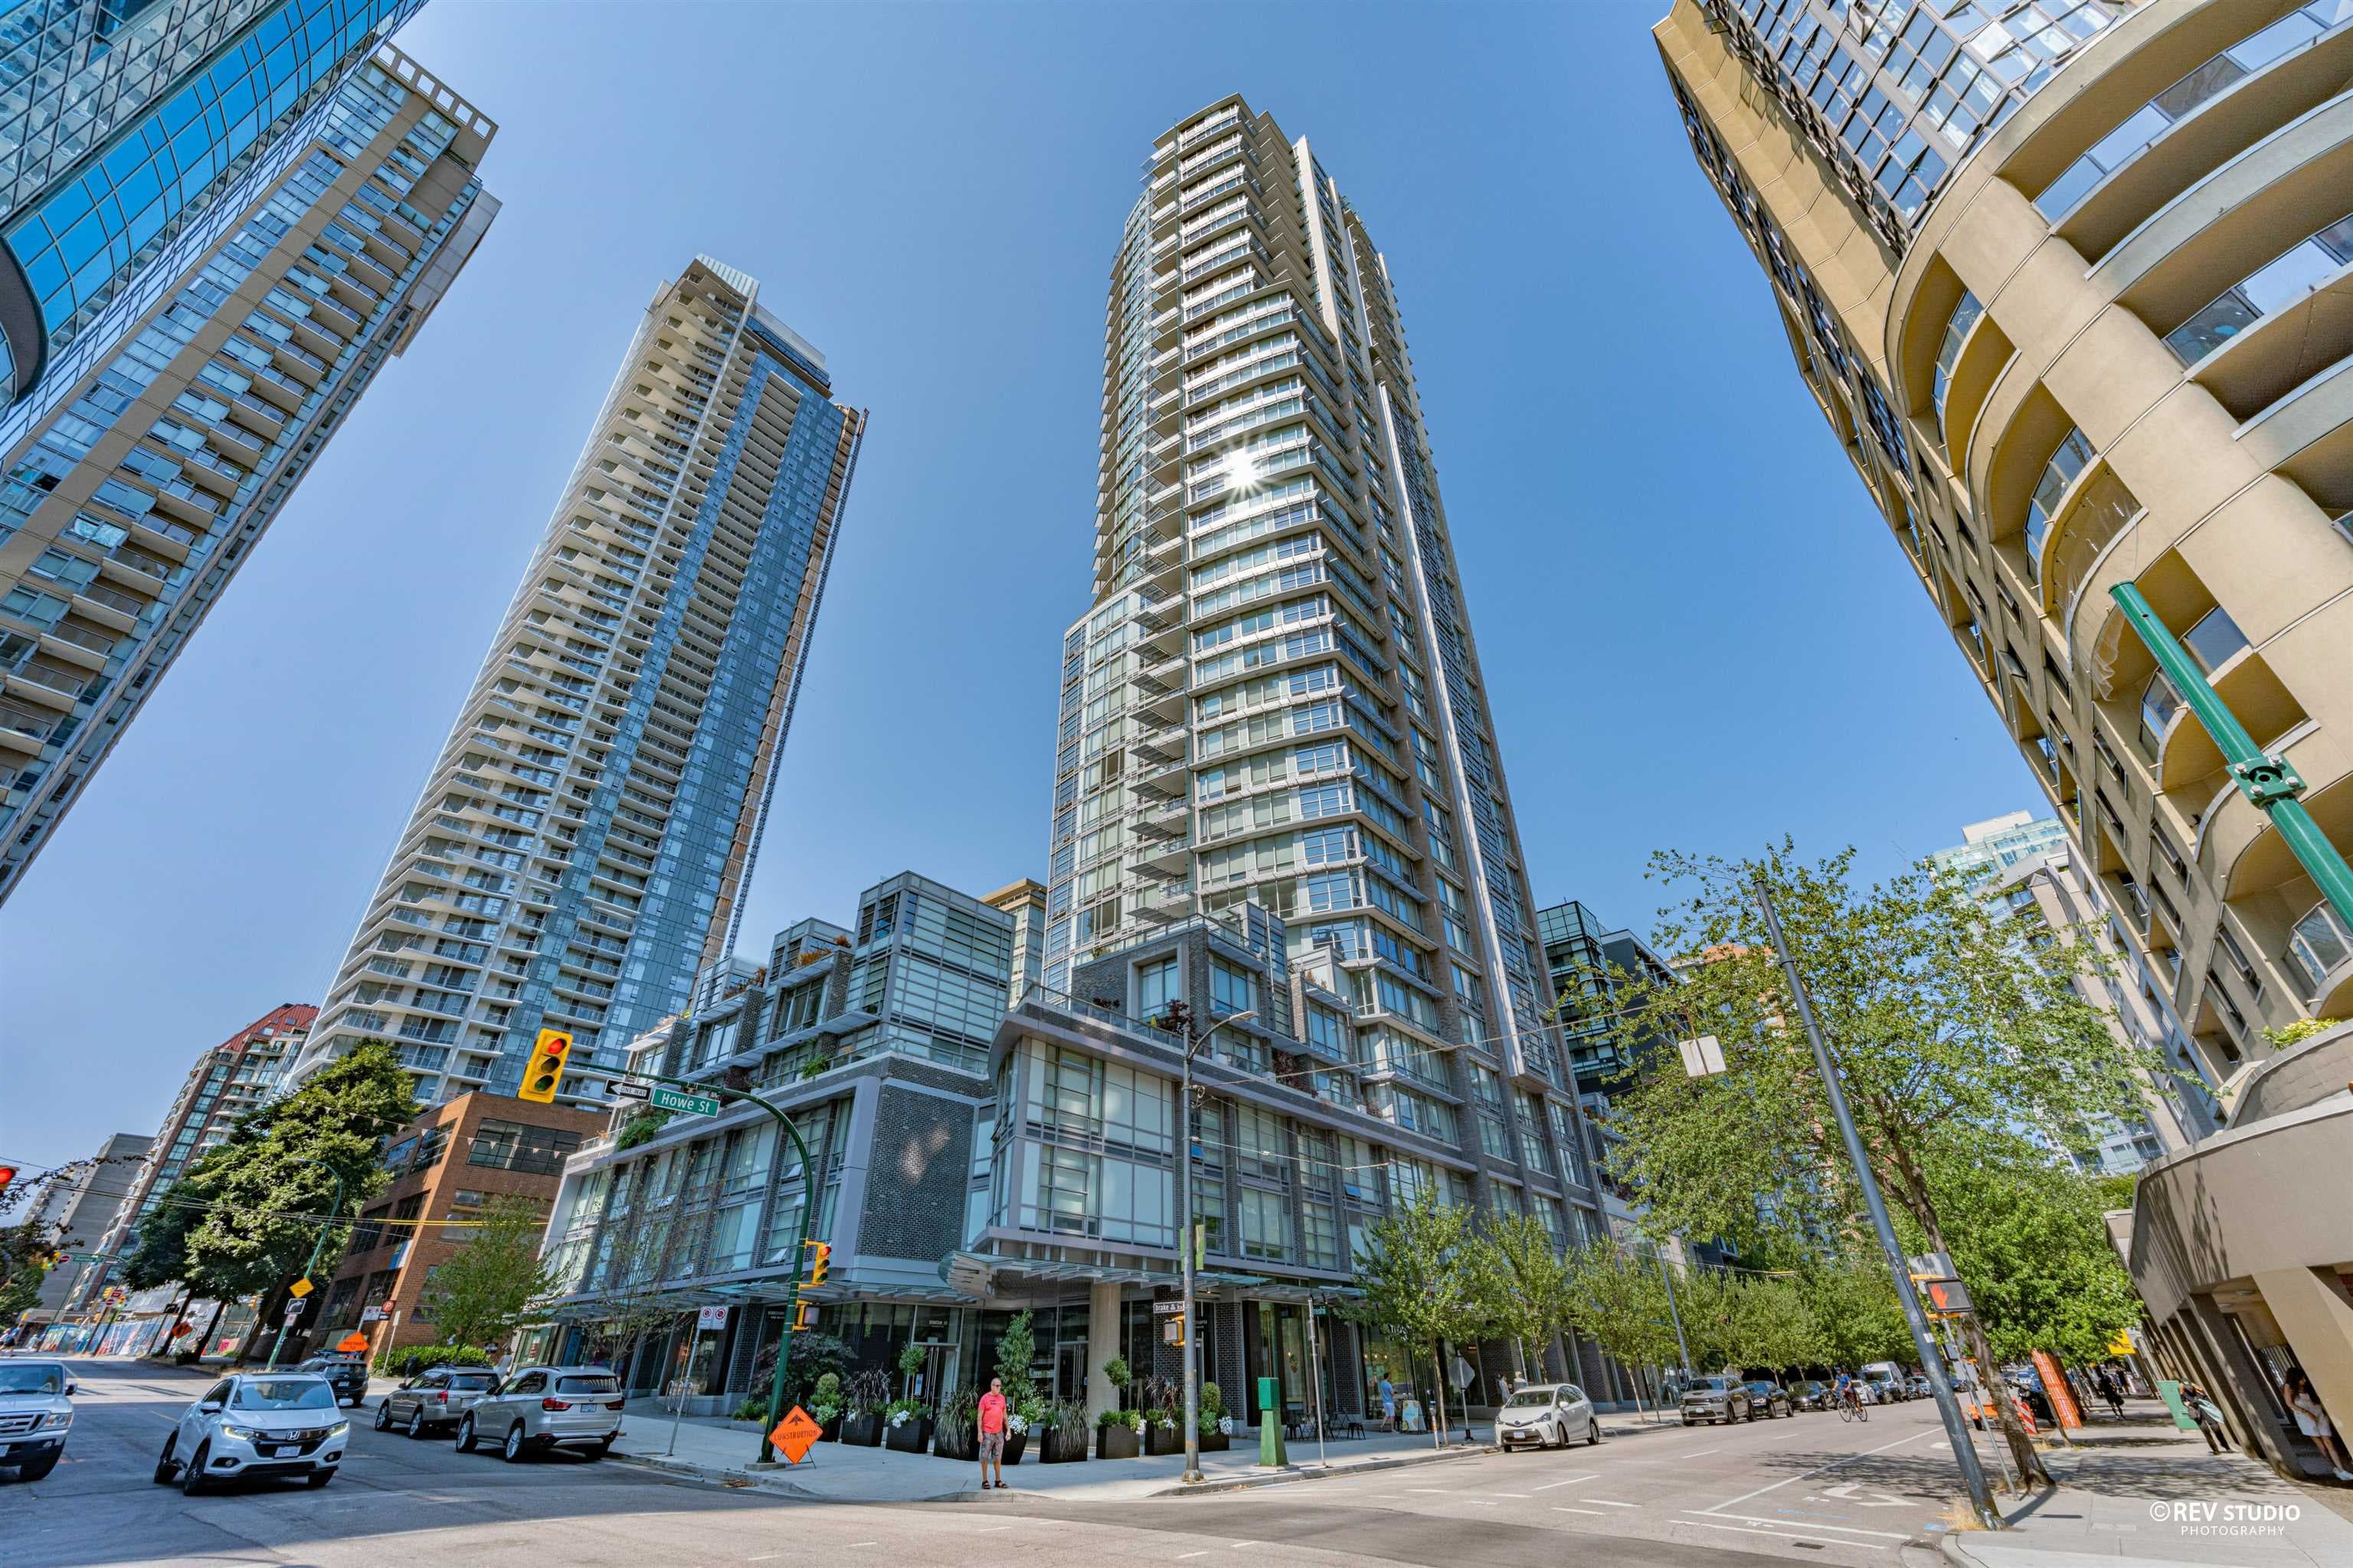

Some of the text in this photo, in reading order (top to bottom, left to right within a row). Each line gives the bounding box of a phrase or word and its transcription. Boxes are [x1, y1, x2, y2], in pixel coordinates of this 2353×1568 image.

[661, 1093, 710, 1113] Howe St
[774, 1429, 817, 1441] CONSTRUCTION
